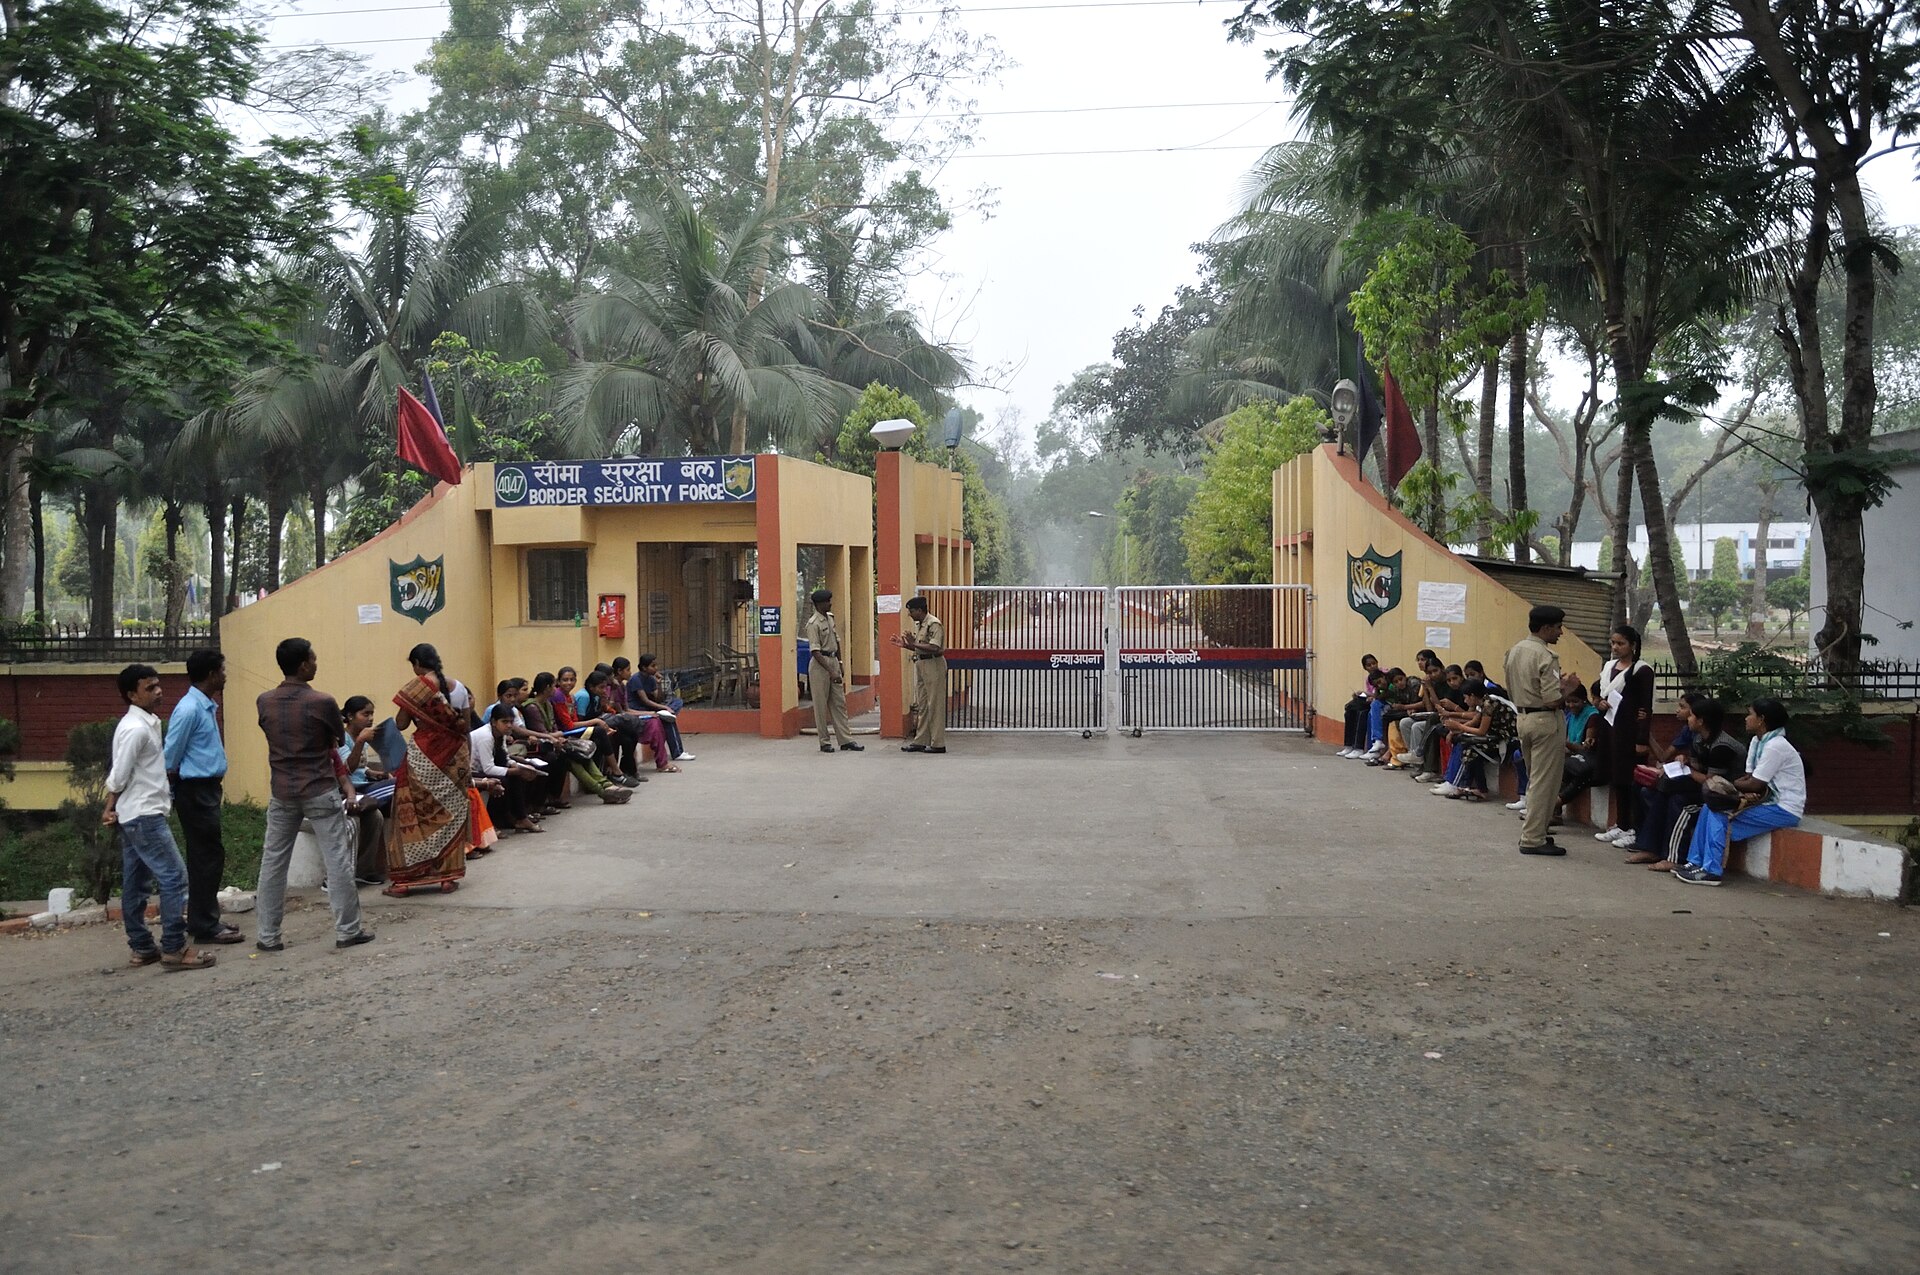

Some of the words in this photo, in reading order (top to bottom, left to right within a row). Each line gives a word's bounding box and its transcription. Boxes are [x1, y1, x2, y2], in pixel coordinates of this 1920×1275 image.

[532, 461, 583, 486] सीमा
[601, 462, 664, 488] सुरक्षा
[681, 461, 716, 483] बल
[529, 487, 588, 505] BORDER
[594, 484, 673, 503] SECURITY
[679, 482, 725, 502] FORCE
[1073, 653, 1103, 665] अपना
[1120, 653, 1150, 664] पहचान
[1151, 653, 1165, 664] पत्र
